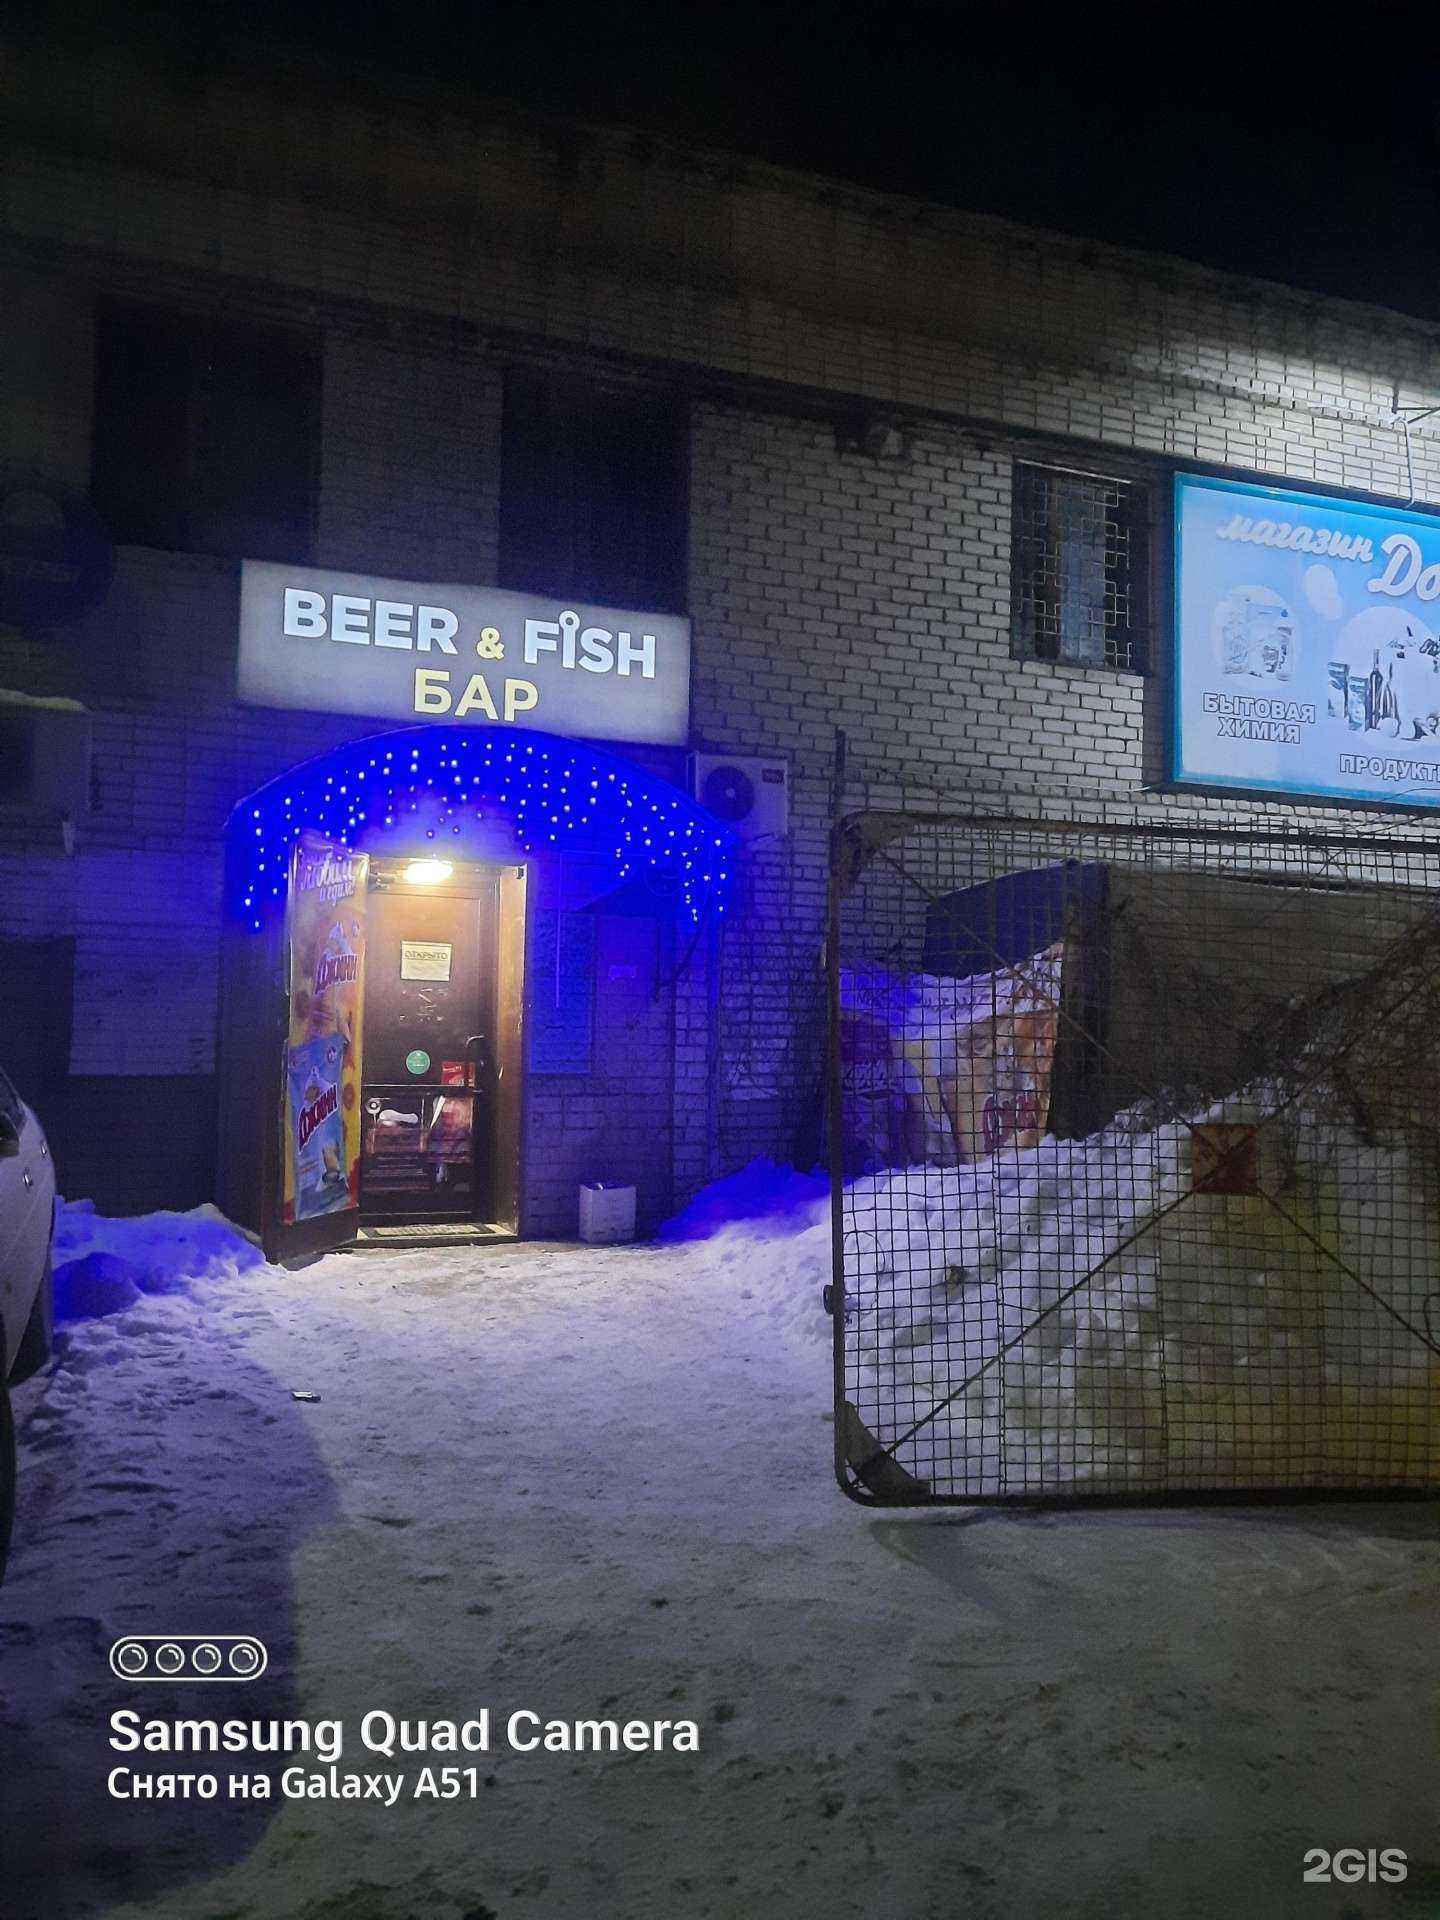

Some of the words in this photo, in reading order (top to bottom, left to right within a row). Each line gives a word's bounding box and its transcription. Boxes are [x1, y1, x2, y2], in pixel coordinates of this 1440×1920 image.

[1216, 513, 1374, 563] магазин
[283, 587, 459, 656] BEER
[475, 626, 505, 661] &
[413, 667, 540, 723] БАР
[1202, 692, 1316, 724] БЫТОВАЯ
[1216, 716, 1301, 745] ХИМИЯ
[1339, 753, 1440, 782] ПРОДУКТ
